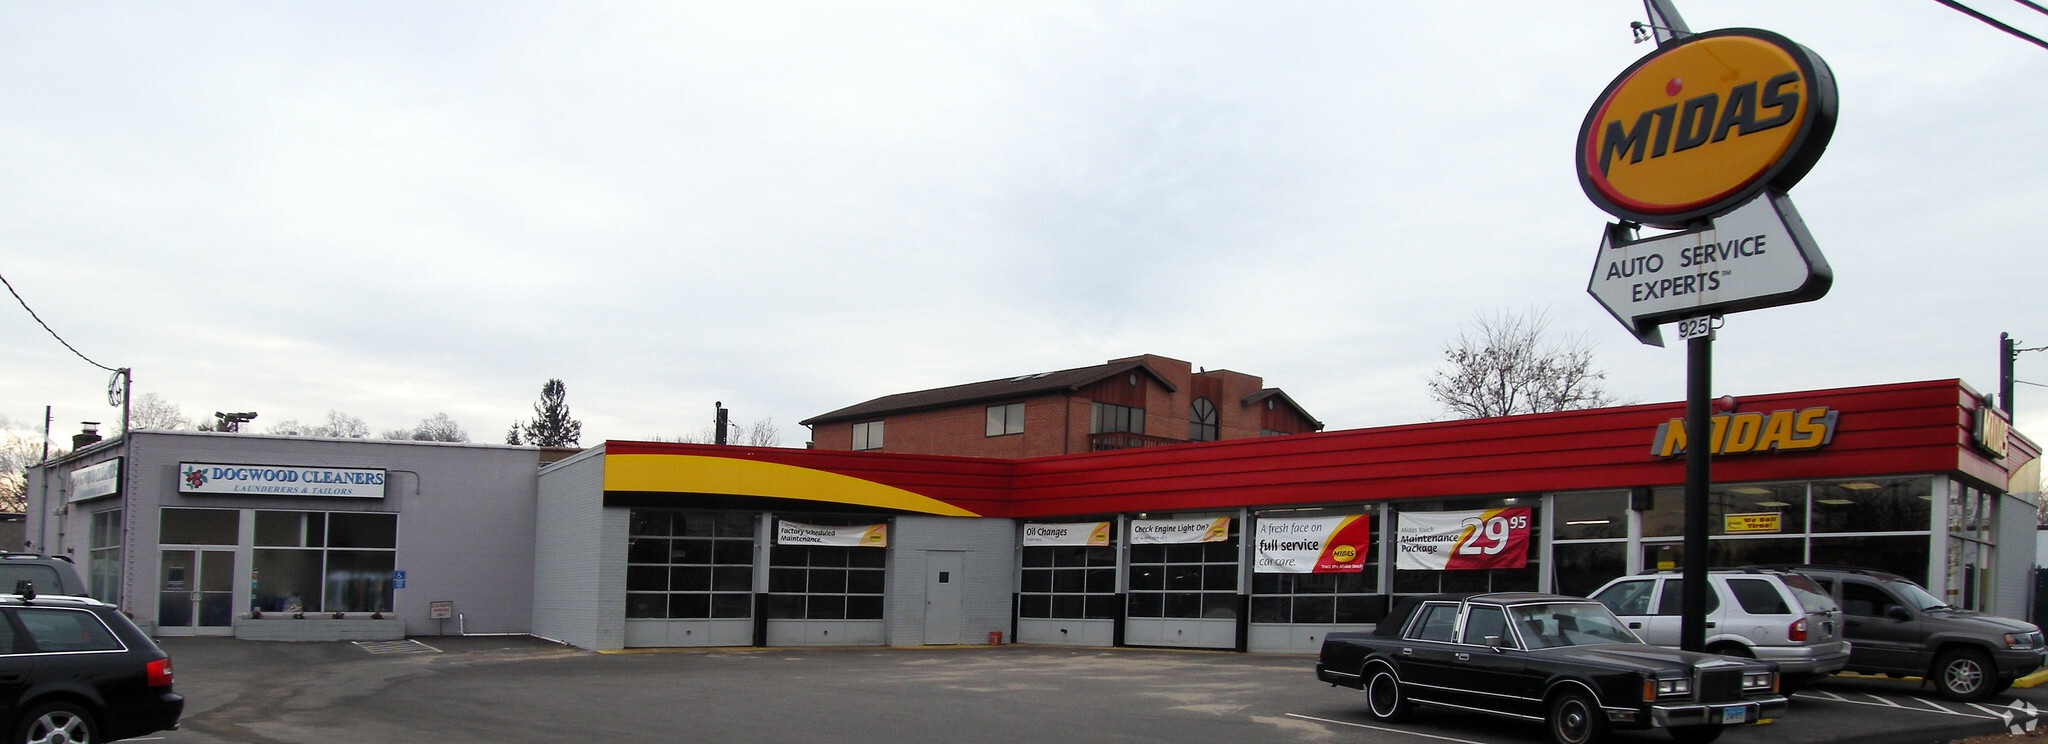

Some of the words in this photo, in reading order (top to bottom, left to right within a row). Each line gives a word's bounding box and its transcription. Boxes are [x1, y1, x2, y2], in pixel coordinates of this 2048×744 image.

[1599, 71, 1800, 178] MIDAS
[1606, 253, 1664, 281] AUTO
[1680, 234, 1766, 268] SERVICE
[1632, 270, 1720, 302] EXPERTS
[1679, 318, 1709, 339] 925
[212, 467, 299, 483] DOGWOOD
[302, 470, 384, 485] CLEANERS
[234, 484, 299, 494] LAUNDERERS
[301, 486, 308, 494] &
[312, 487, 353, 496] TAILORS
[781, 527, 804, 536] Factory
[1026, 527, 1036, 536] Oil
[1037, 527, 1067, 538] Changes
[1134, 525, 1153, 533] Check
[1154, 525, 1176, 534] Engine
[1177, 524, 1194, 533] Light
[1196, 523, 1209, 532] On?
[1260, 525, 1266, 533] A
[1268, 523, 1288, 535] fresh
[1290, 523, 1308, 535] face
[1311, 524, 1322, 532] on
[1400, 534, 1459, 543] Maintenance
[1259, 539, 1278, 554] full
[1281, 538, 1319, 551] service
[1401, 543, 1438, 555] Package
[1333, 550, 1355, 558] MIDAS
[1259, 558, 1273, 567] car
[1275, 558, 1296, 567] care.
